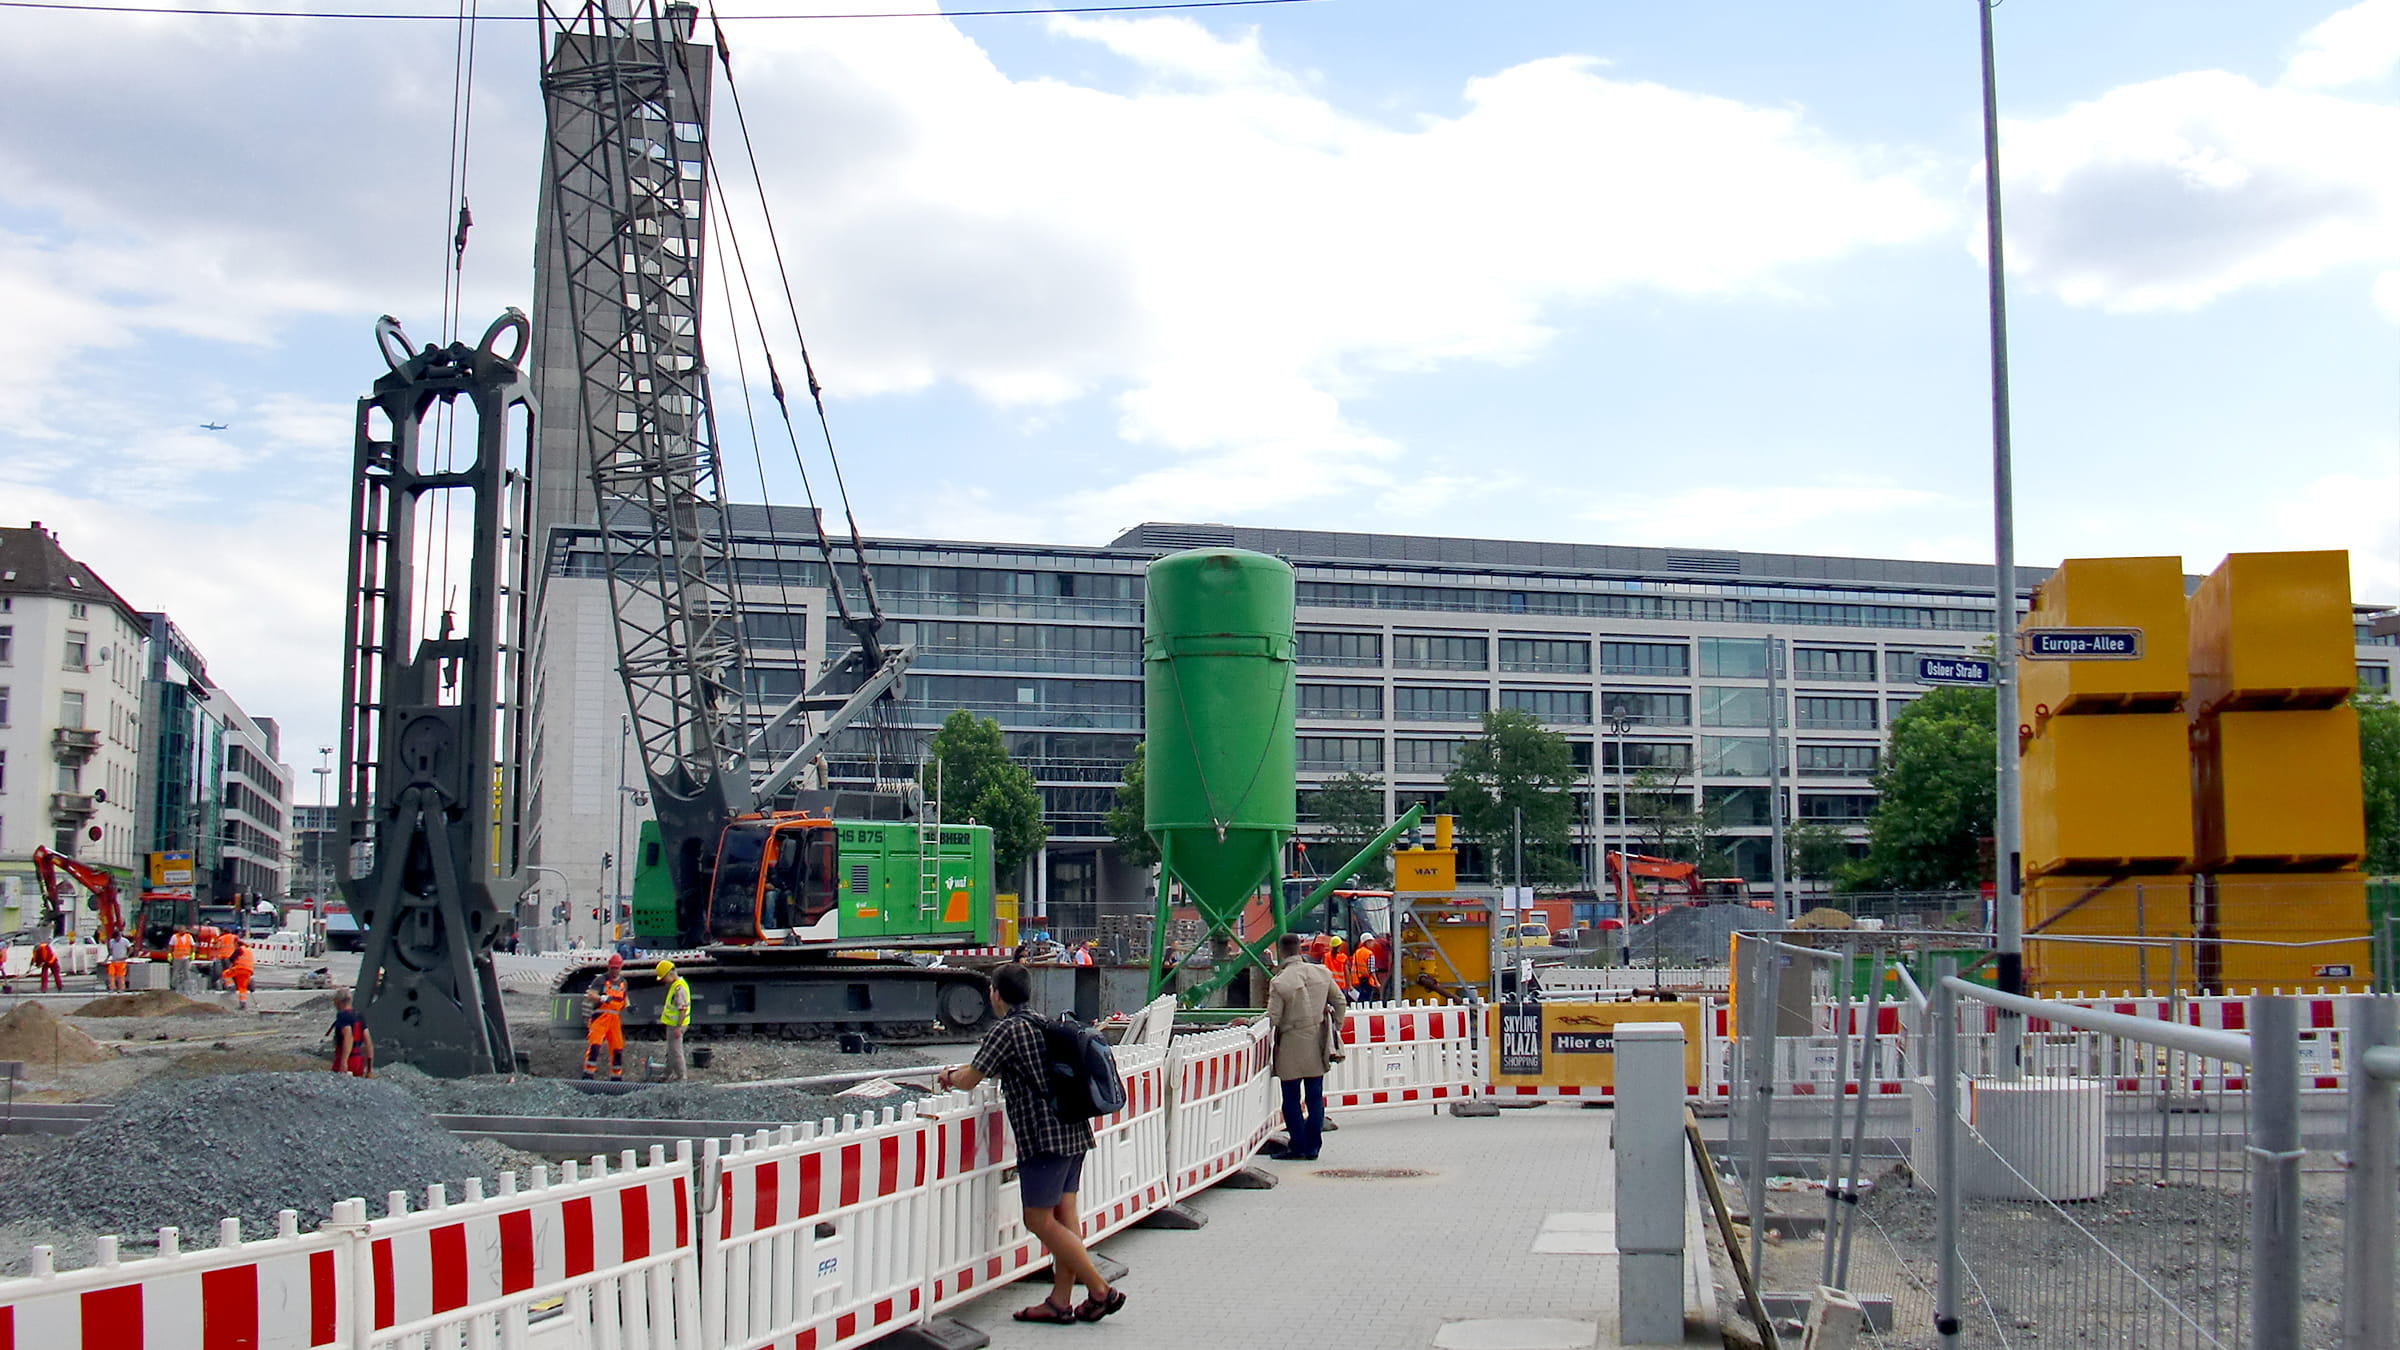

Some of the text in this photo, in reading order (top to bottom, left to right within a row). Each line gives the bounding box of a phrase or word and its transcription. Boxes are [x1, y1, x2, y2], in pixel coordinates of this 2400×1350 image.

[2042, 636, 2124, 653] Europa-Allee
[1927, 661, 1982, 678] Osloer Straße
[858, 831, 883, 843] 875
[1503, 1014, 1538, 1032] SKYLINE
[1503, 1033, 1538, 1055] PLAZA
[1558, 1036, 1591, 1048] Hier
[1503, 1056, 1538, 1066] SHOPPING
